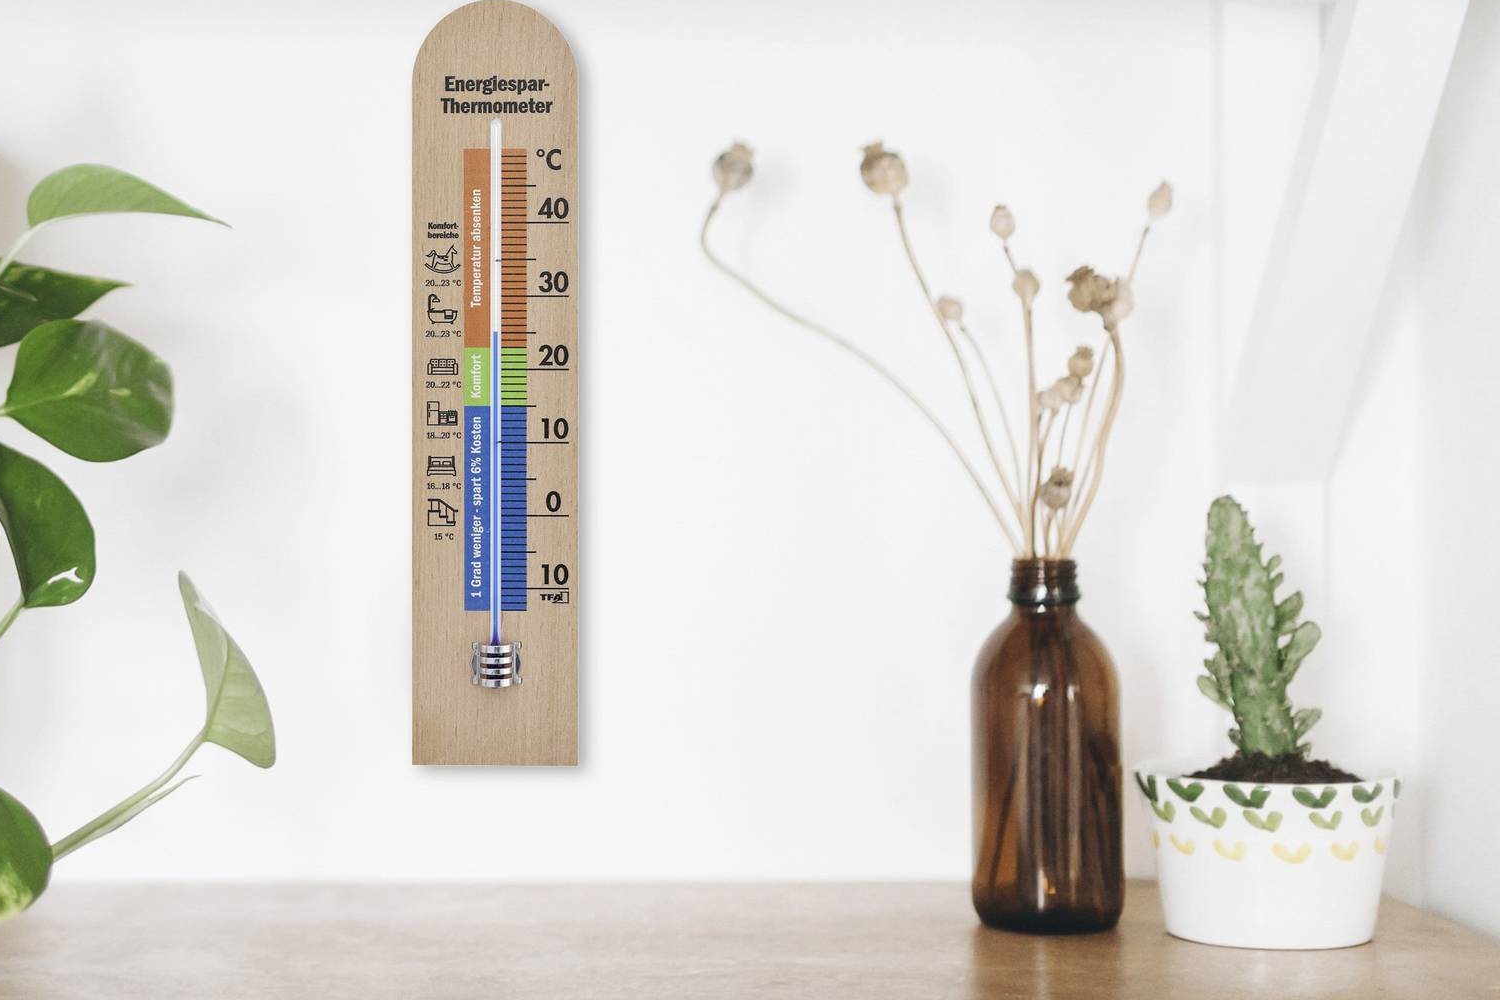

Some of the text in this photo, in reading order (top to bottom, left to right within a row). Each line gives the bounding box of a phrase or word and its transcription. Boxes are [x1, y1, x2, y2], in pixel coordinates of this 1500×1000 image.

[444, 75, 550, 95] Energiespar-
[440, 97, 553, 114] Thermometer
[536, 148, 562, 170] °C
[538, 197, 569, 219] 40
[427, 222, 459, 230] Komfort-
[427, 231, 459, 239] bereiche
[470, 188, 483, 308] Temperatur absenken
[538, 271, 569, 293] 30
[538, 344, 569, 366] 20
[470, 354, 482, 399] Komfort
[470, 416, 482, 454] Kosten
[541, 417, 569, 439] 10
[470, 457, 482, 474] 6%
[470, 477, 484, 506] spart
[545, 491, 562, 512] 0
[434, 533, 443, 541] 15
[470, 515, 484, 558] weniger
[470, 561, 482, 588] Grad
[541, 563, 569, 585] 10
